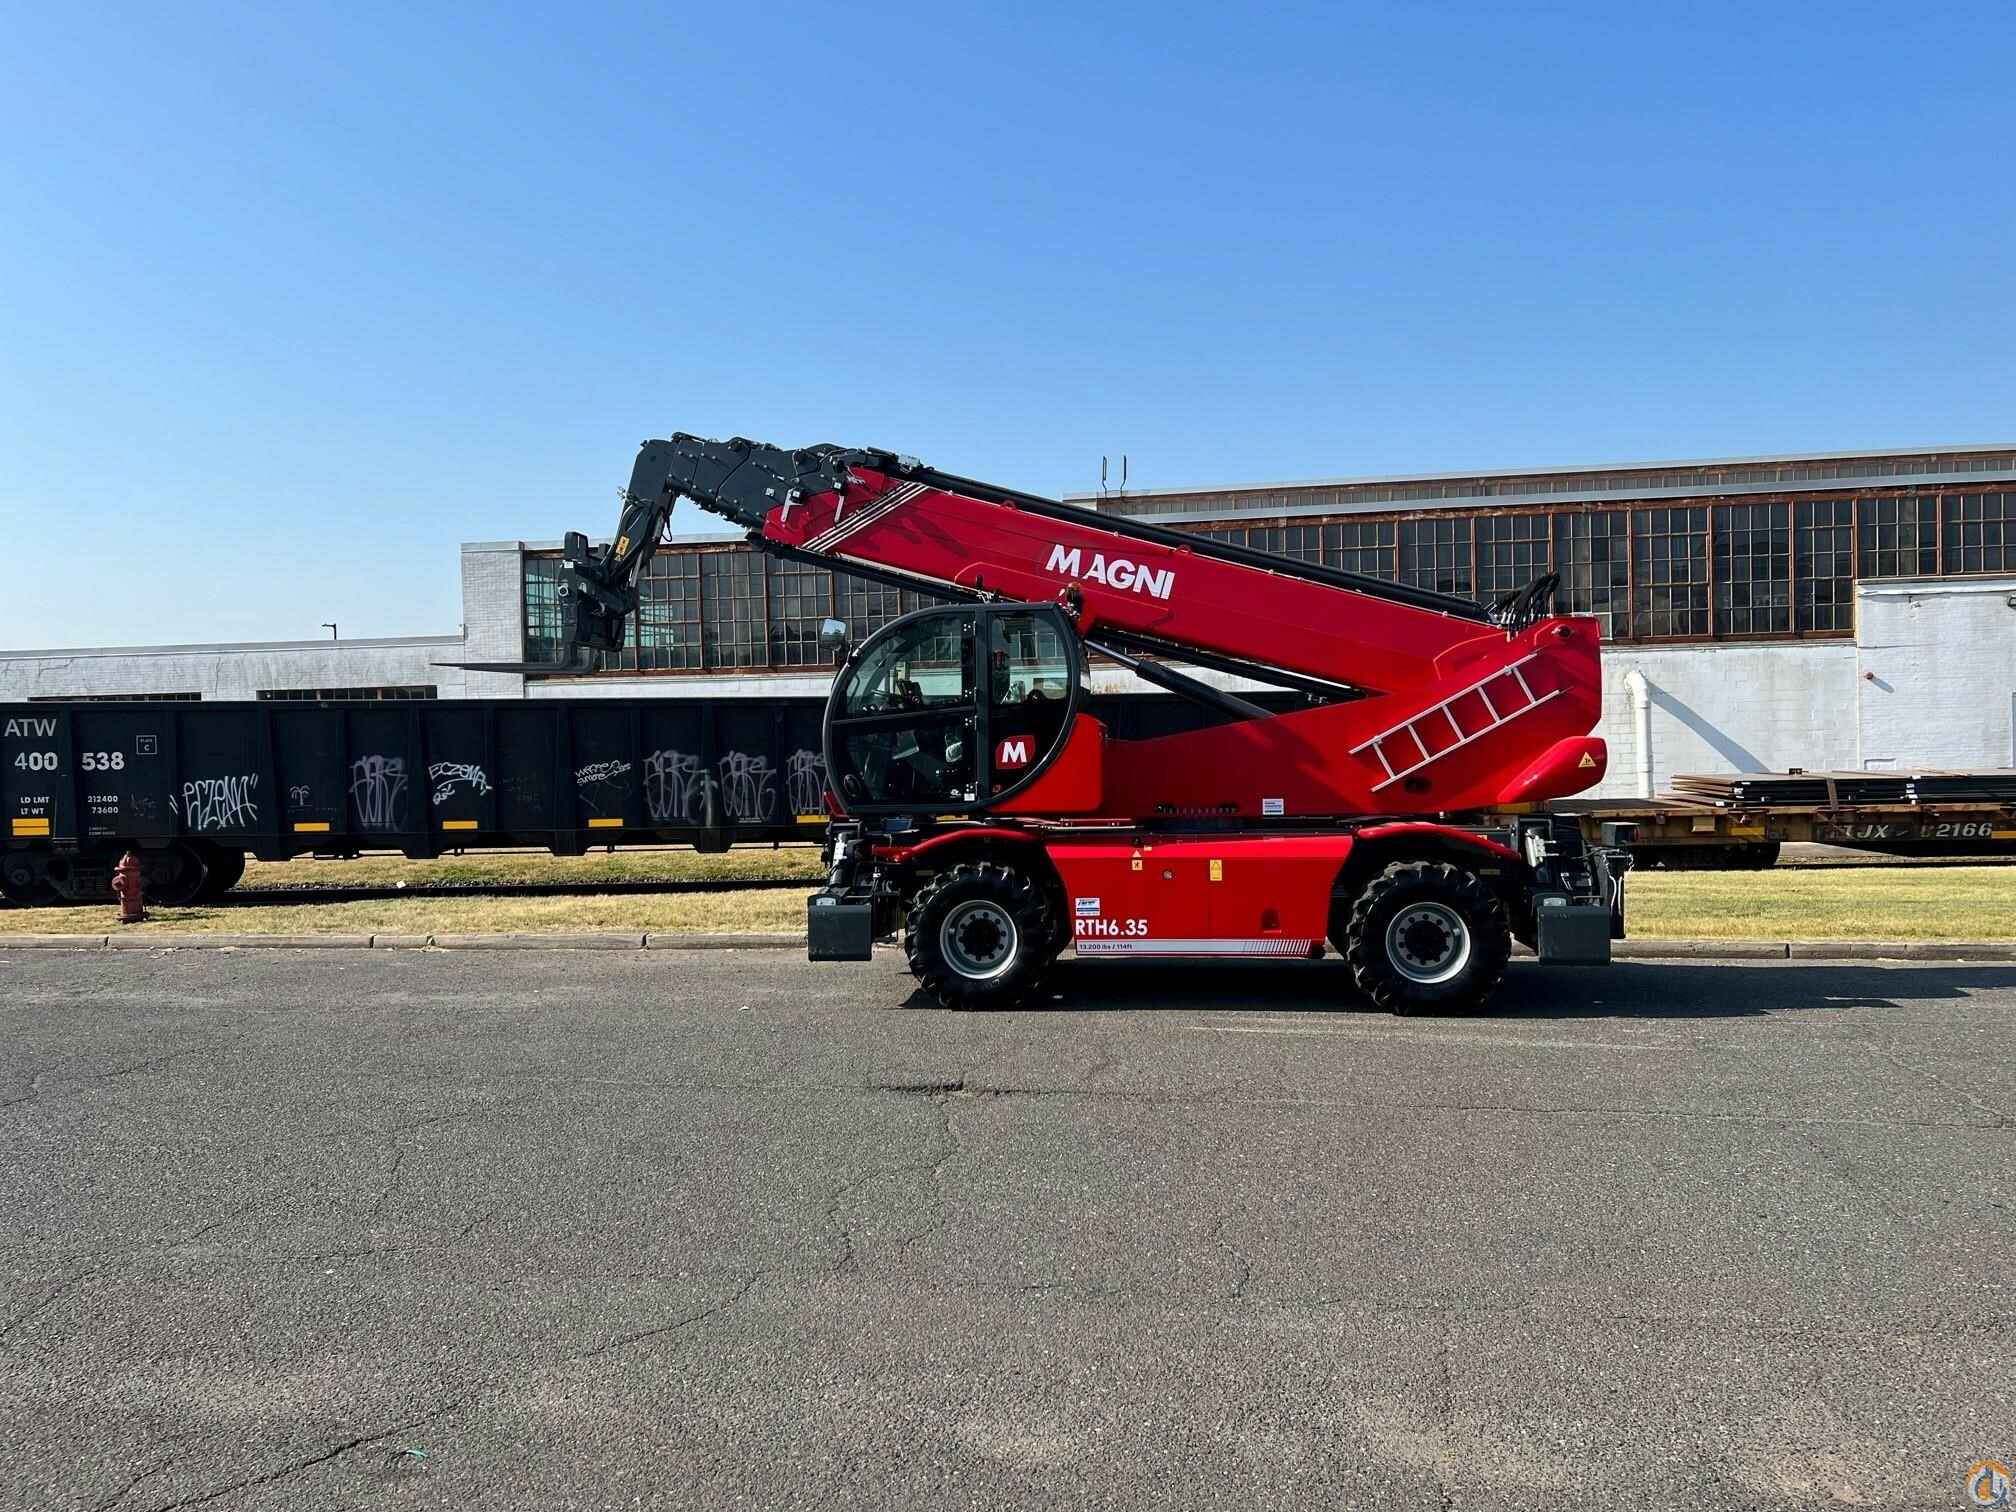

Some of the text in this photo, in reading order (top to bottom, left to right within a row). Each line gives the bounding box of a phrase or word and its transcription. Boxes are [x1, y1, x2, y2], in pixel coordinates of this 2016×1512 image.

[1045, 544, 1176, 600] MAGNI
[4, 718, 57, 737] ATW
[14, 752, 125, 771] 400 538
[1002, 742, 1027, 763] M
[20, 796, 31, 804] LD
[33, 796, 50, 804] LMT
[20, 807, 30, 815] LT
[31, 807, 45, 815] WT
[1075, 919, 1148, 936] RTH6.35
